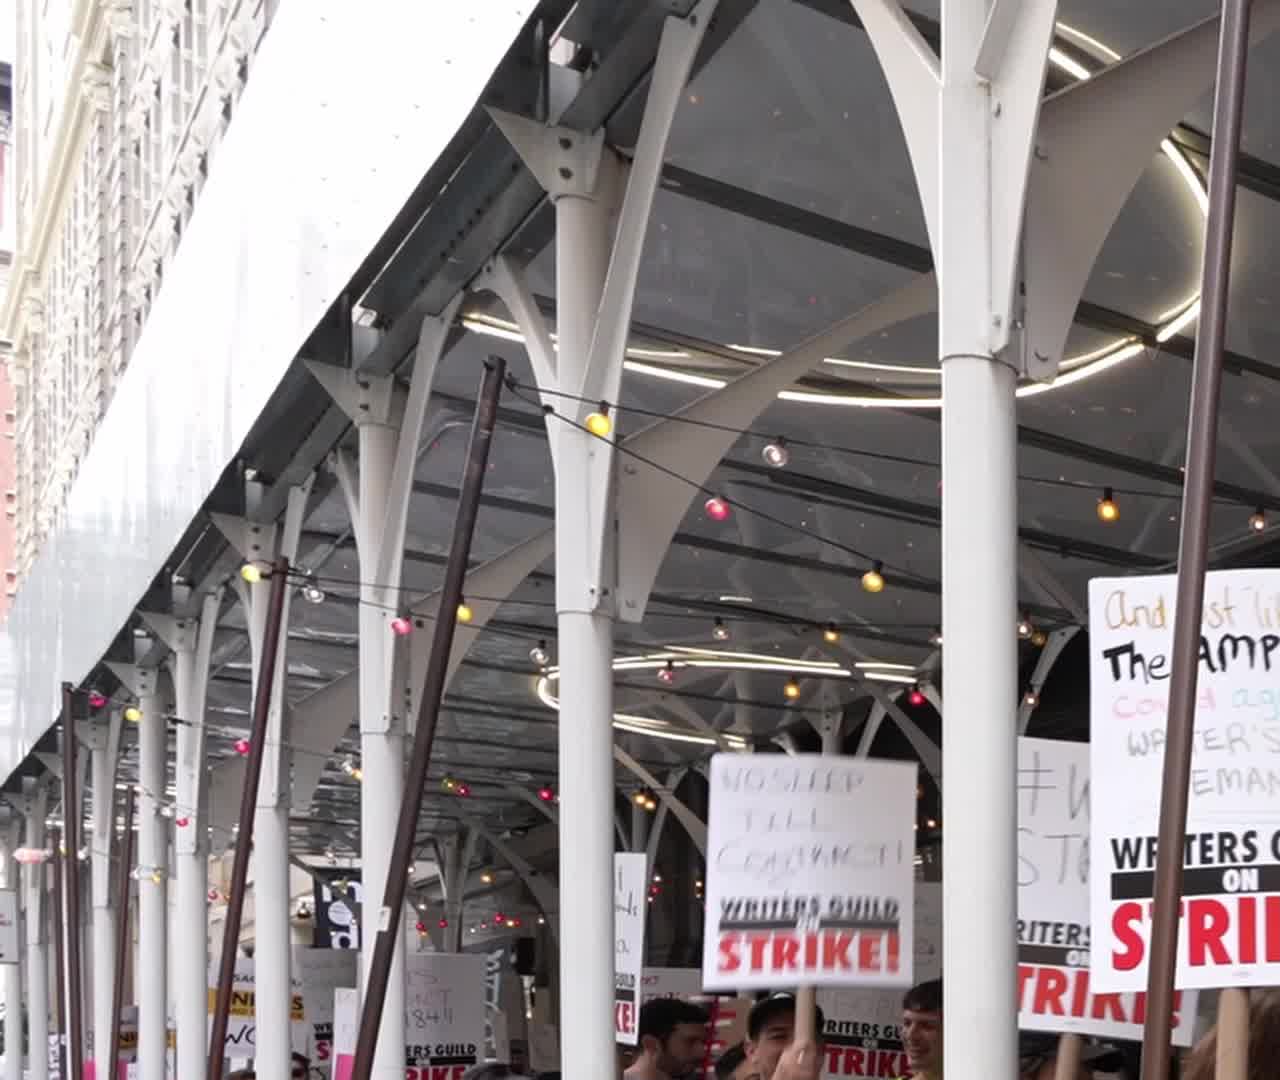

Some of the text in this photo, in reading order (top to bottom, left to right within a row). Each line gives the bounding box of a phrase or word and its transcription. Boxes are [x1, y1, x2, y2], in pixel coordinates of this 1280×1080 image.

[1103, 640, 1171, 685] The
[1111, 830, 1258, 870] WRTERS
[1222, 868, 1259, 892] ON
[720, 893, 899, 921] WRITERS GUILD
[718, 929, 900, 974] STRIKE!
[825, 1019, 880, 1039] RITERS
